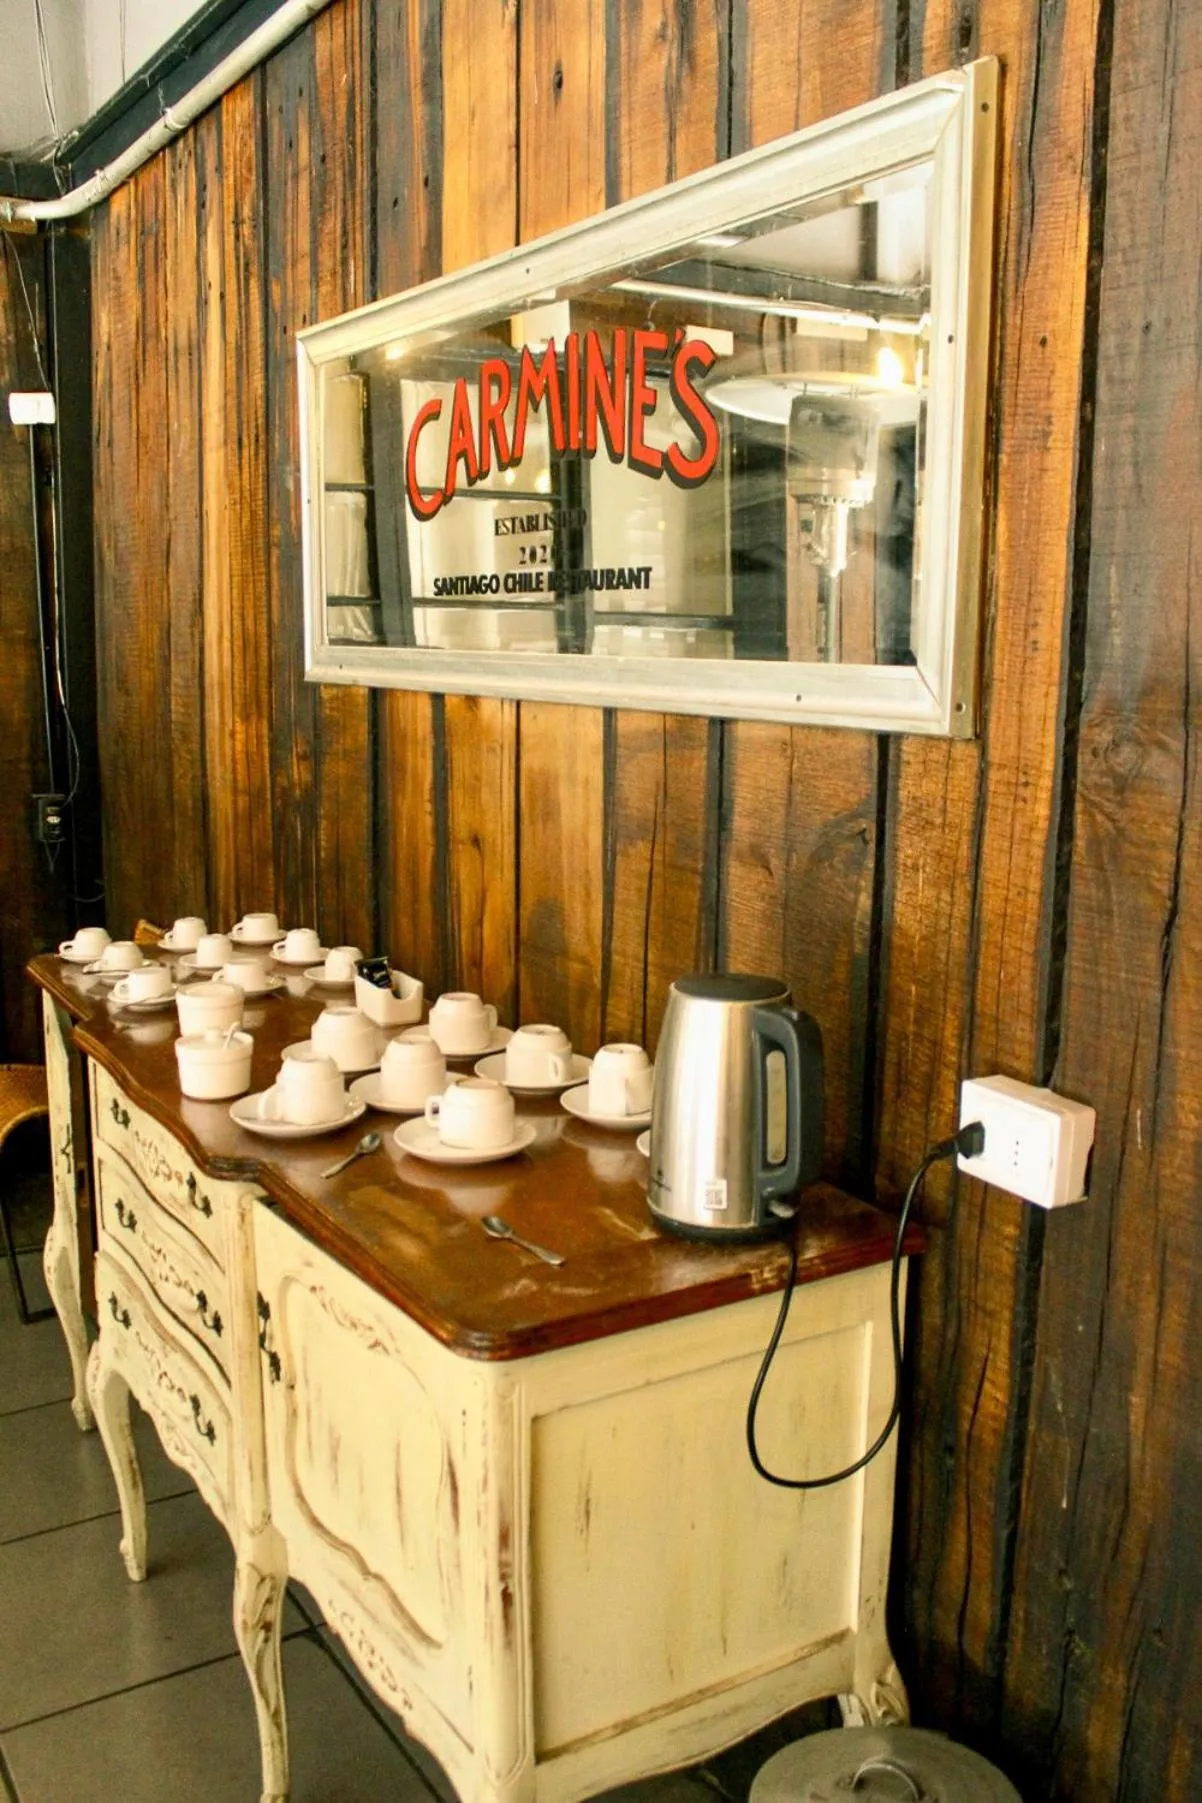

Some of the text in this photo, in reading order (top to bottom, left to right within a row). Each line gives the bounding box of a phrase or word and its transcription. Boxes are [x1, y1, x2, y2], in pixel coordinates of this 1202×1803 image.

[406, 327, 721, 520] CARMINE'S
[433, 571, 500, 597] SANTIAGO
[502, 570, 543, 594] CHILE
